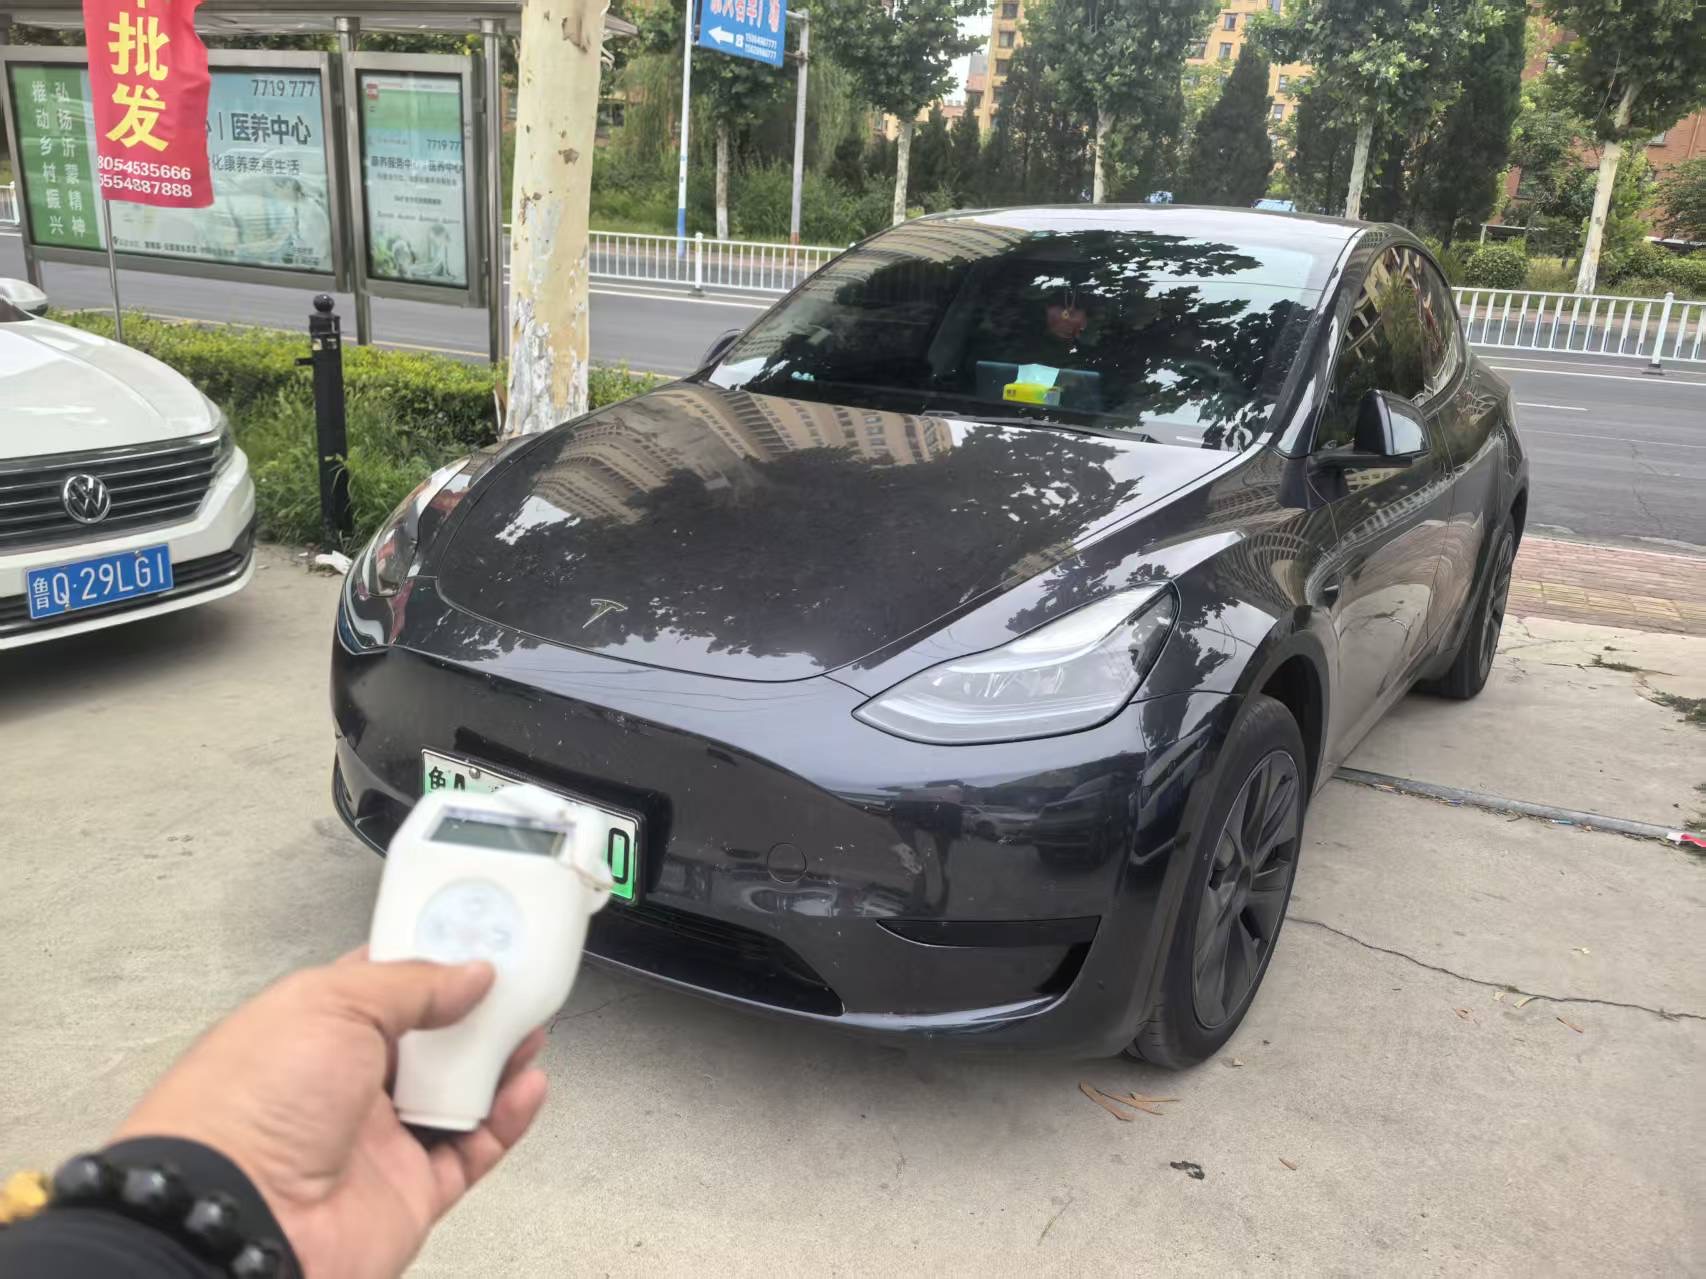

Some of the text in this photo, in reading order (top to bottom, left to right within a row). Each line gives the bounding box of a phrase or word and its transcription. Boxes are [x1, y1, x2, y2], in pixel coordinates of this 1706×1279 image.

[105, 0, 171, 152] 批发
[231, 112, 312, 145] 医养中心
[251, 79, 315, 97] 7719 777
[31, 80, 64, 236] 推动乡村振兴
[54, 81, 87, 239] 弘扬沂蒙精神
